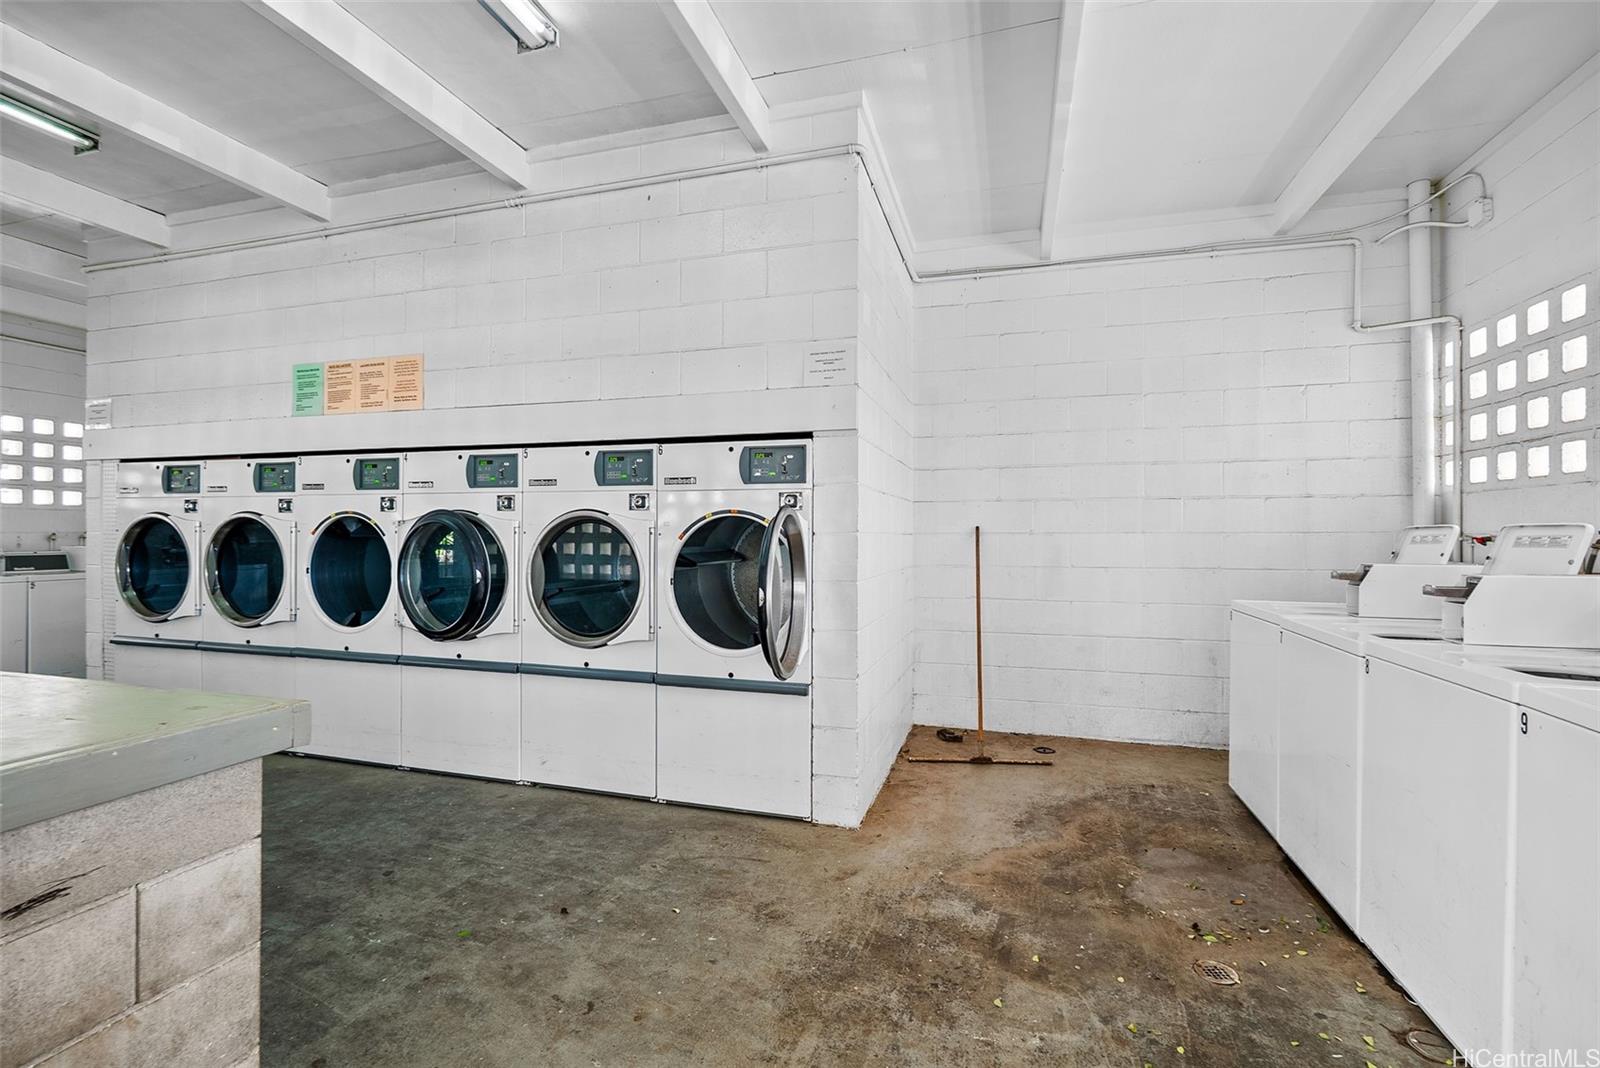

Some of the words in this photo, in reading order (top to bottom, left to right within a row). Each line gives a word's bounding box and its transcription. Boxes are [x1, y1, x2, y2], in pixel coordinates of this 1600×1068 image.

[523, 448, 528, 458] 5
[658, 445, 663, 455] 6
[1365, 658, 1370, 675] 8
[1520, 712, 1528, 735] 9
